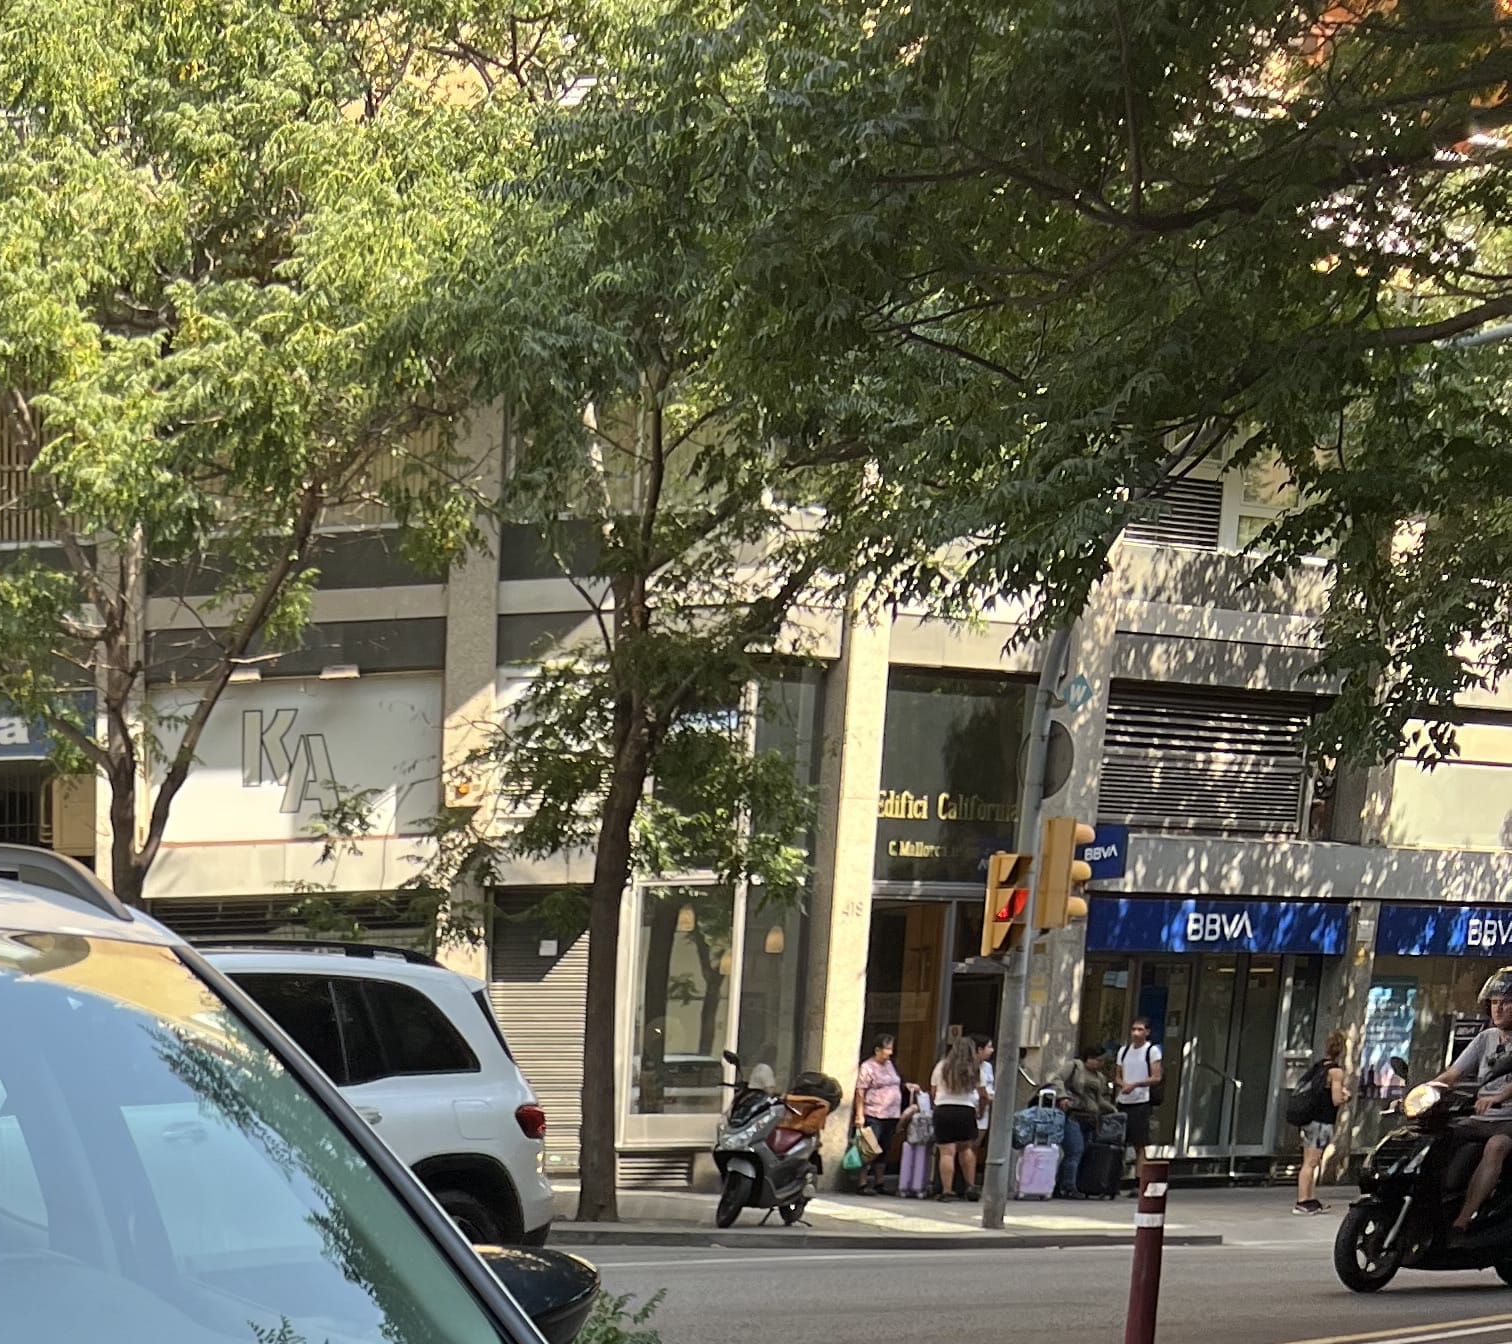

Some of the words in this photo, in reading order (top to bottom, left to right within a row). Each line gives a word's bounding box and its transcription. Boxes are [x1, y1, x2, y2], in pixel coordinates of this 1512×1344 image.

[877, 790, 929, 820] Edifici
[1084, 844, 1118, 862] BBVA
[1187, 910, 1254, 942] BBVA
[1467, 918, 1512, 947] BBV
